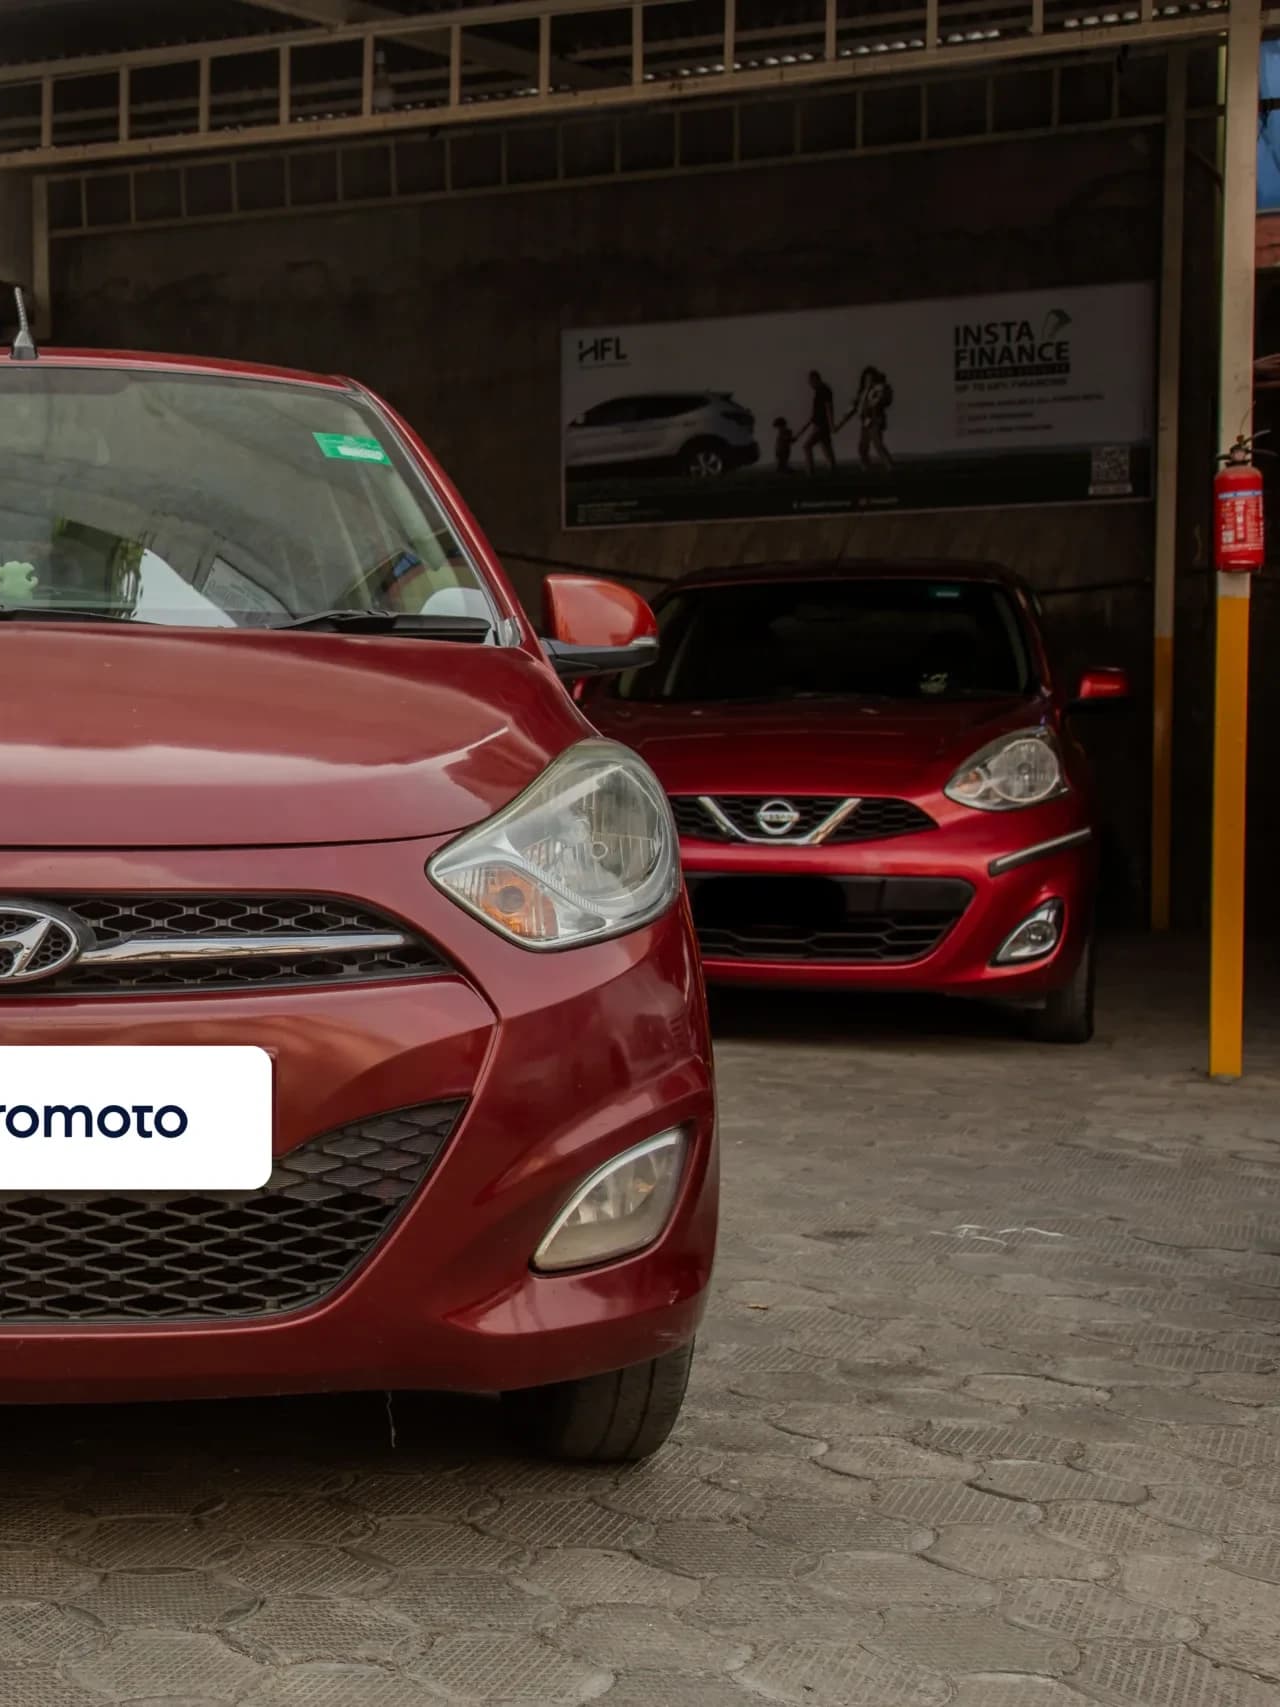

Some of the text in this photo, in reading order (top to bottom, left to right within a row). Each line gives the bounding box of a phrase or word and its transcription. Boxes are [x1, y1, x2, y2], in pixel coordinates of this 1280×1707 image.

[954, 320, 1033, 346] INSTA
[578, 336, 628, 362] HFL
[954, 341, 1070, 368] FINANCE
